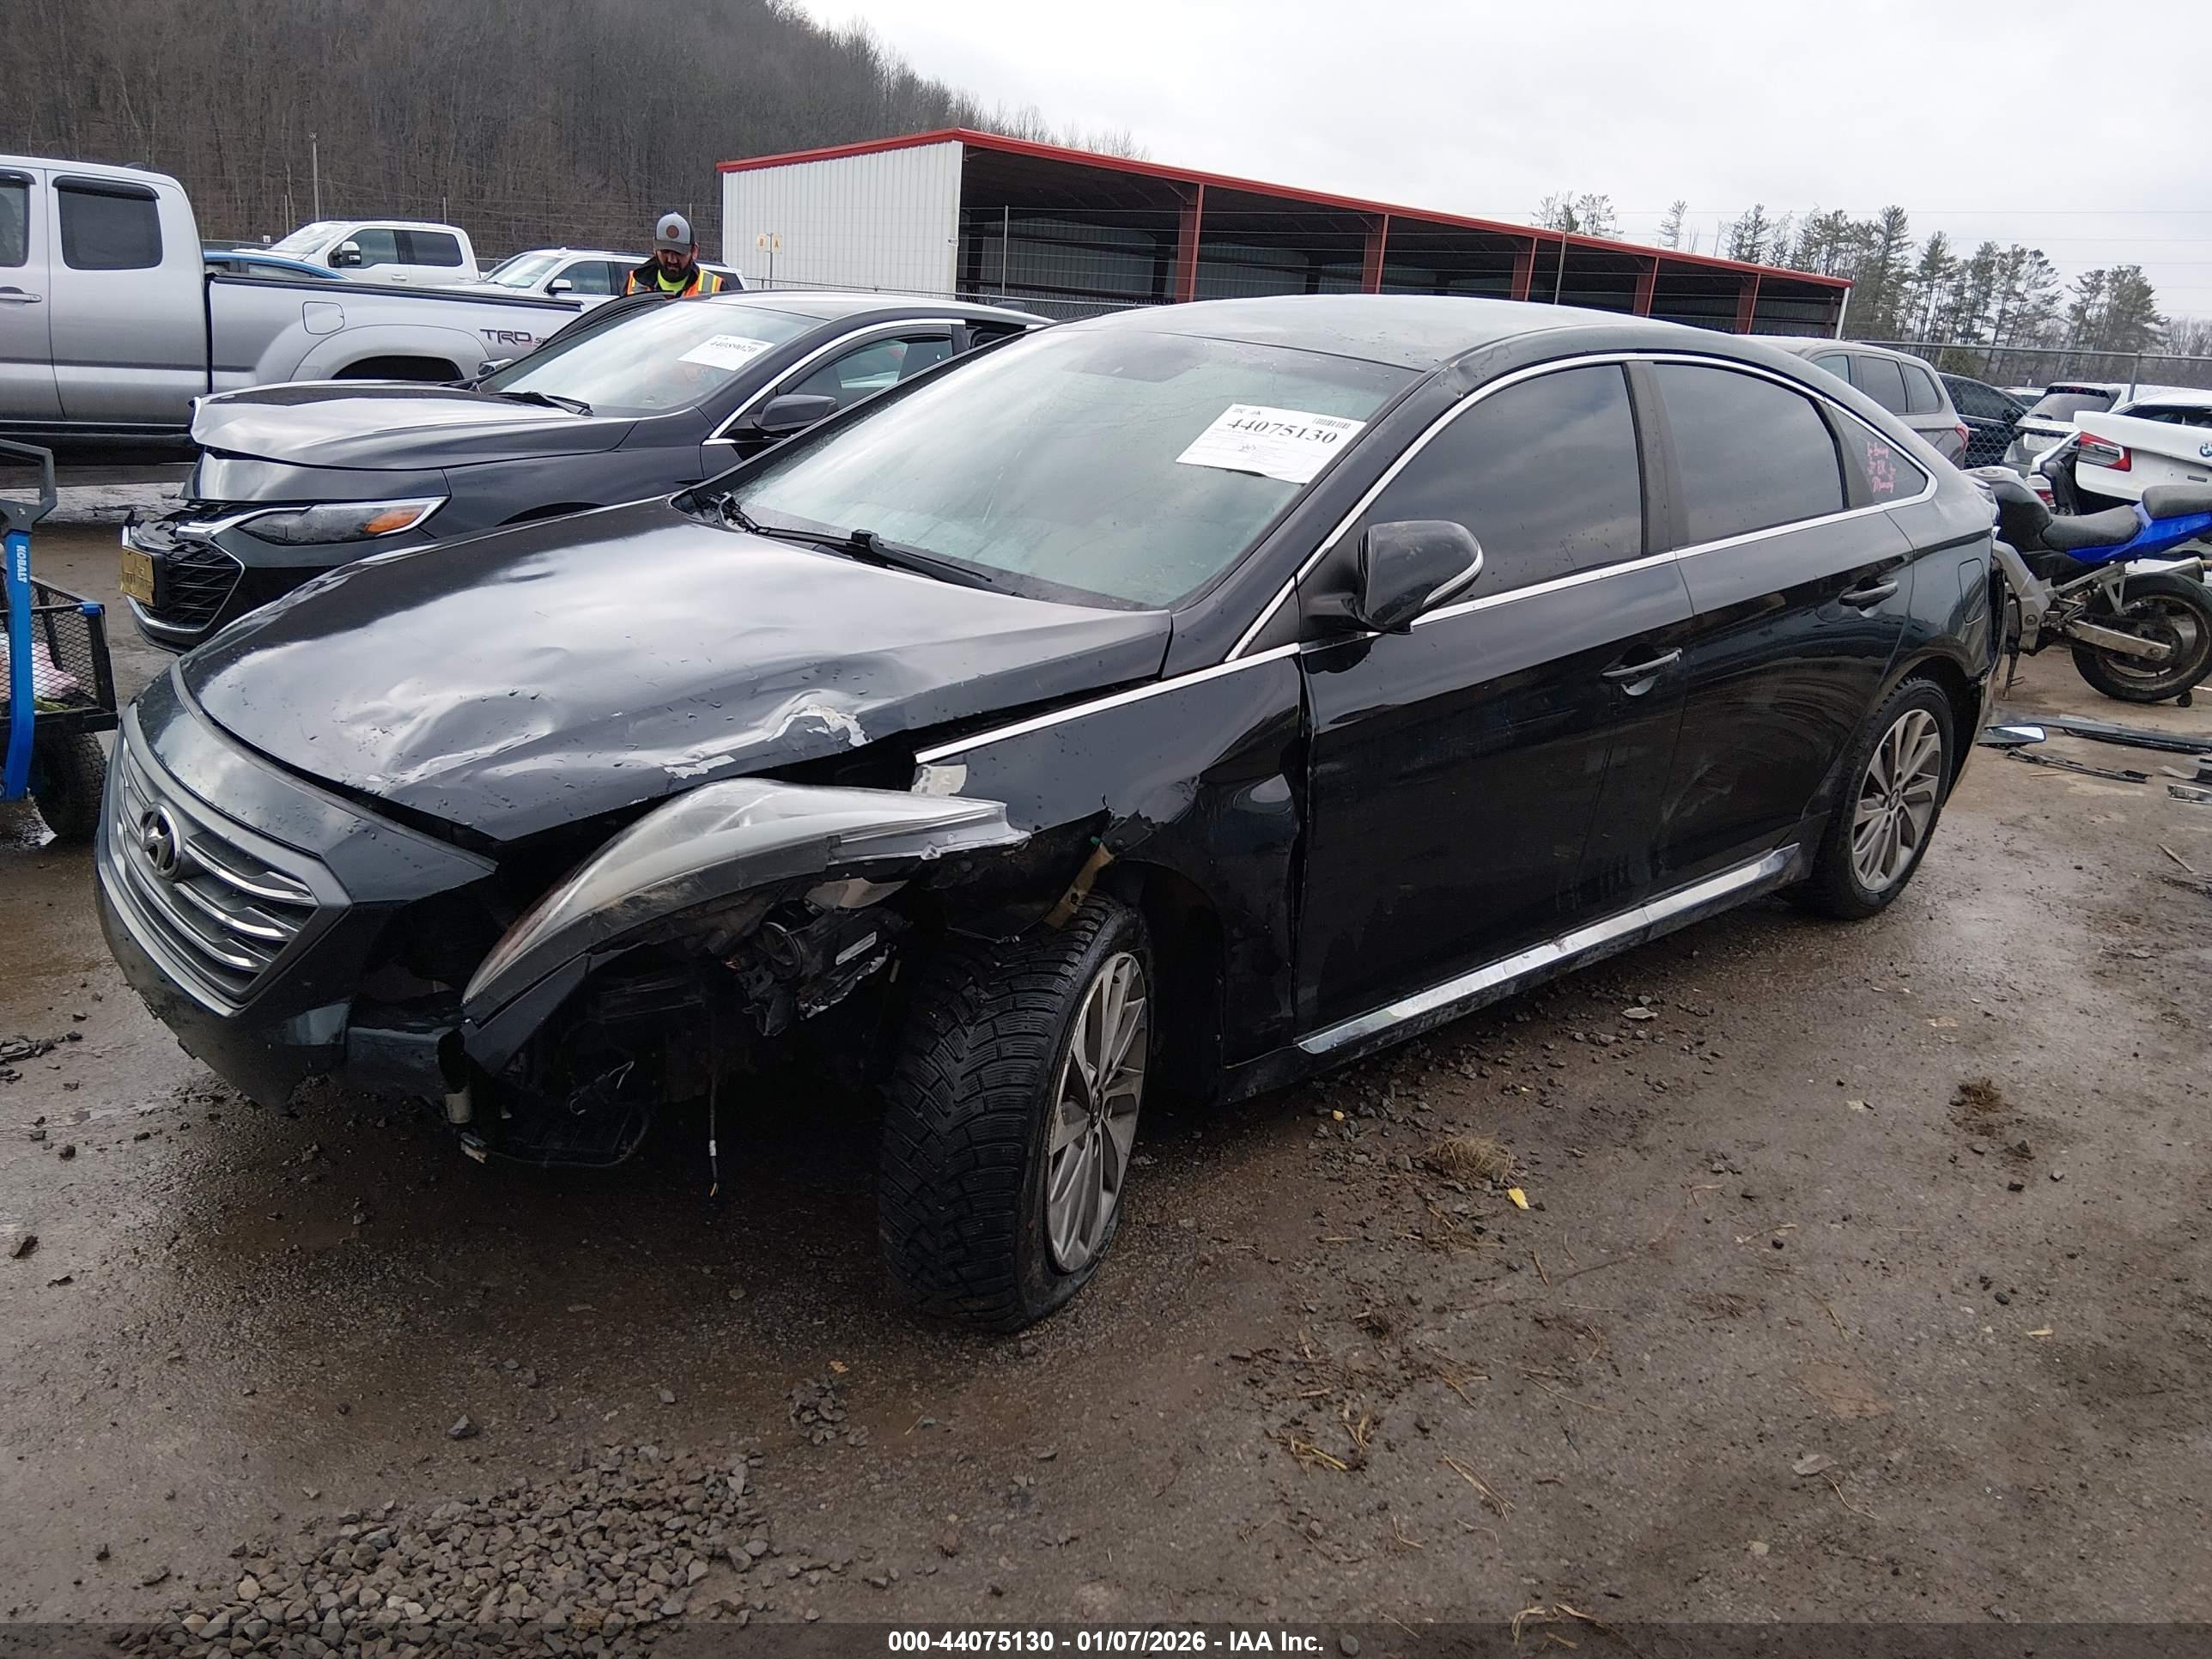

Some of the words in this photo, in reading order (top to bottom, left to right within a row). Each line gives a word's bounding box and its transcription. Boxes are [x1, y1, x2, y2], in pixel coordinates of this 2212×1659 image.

[479, 328, 532, 346] TRD
[1227, 419, 1338, 443] 44075130
[15, 545, 27, 583] KOBALT
